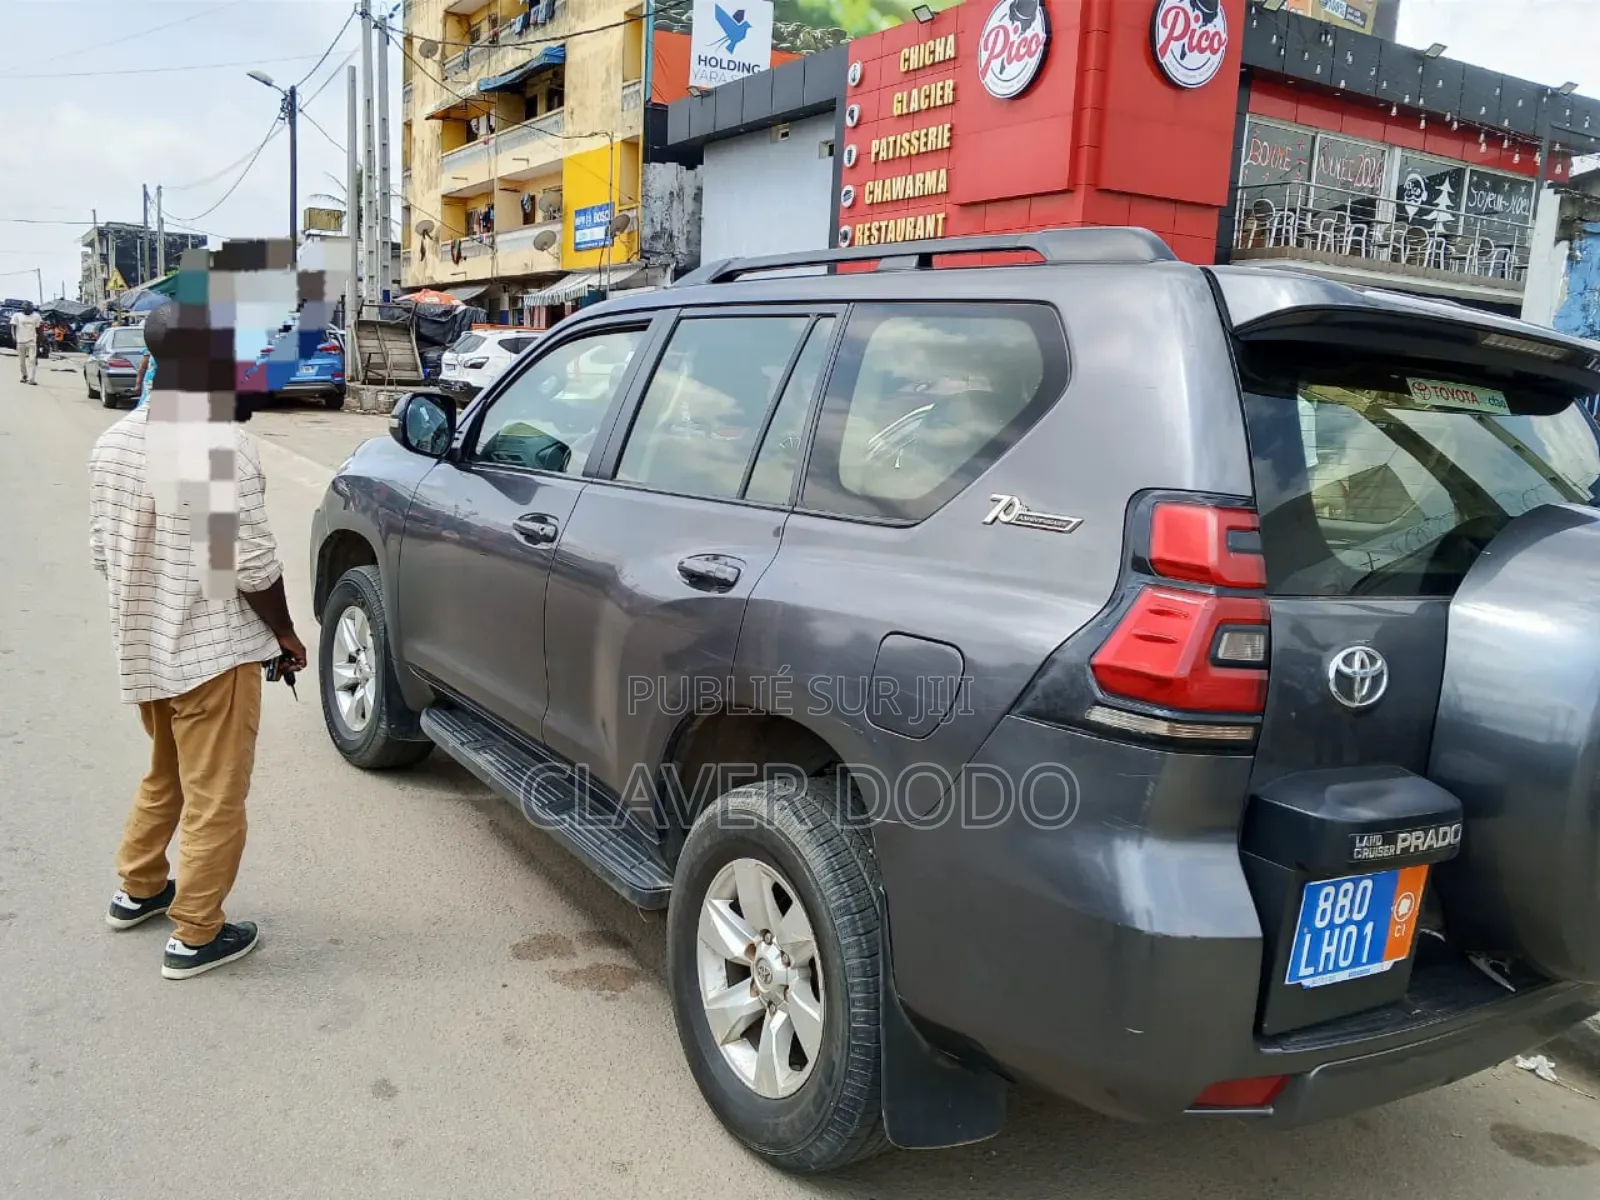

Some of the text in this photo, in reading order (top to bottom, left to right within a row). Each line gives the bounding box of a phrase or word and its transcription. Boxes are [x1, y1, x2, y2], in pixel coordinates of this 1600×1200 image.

[1158, 5, 1227, 60] Pico
[698, 54, 761, 75] HOLDING
[899, 33, 956, 73] CHICHA
[979, 24, 1046, 81] Pico
[892, 78, 955, 117] GLACIER
[870, 123, 952, 164] PATISSERIE
[864, 168, 948, 206] CHAWARMA
[854, 211, 947, 247] RESTAURANT
[1430, 385, 1481, 406] TOYOTA
[1353, 844, 1396, 860] CRUISER
[1355, 823, 1463, 854] LAND PRADO
[1314, 878, 1374, 929] 880
[1298, 921, 1375, 977] LH01
